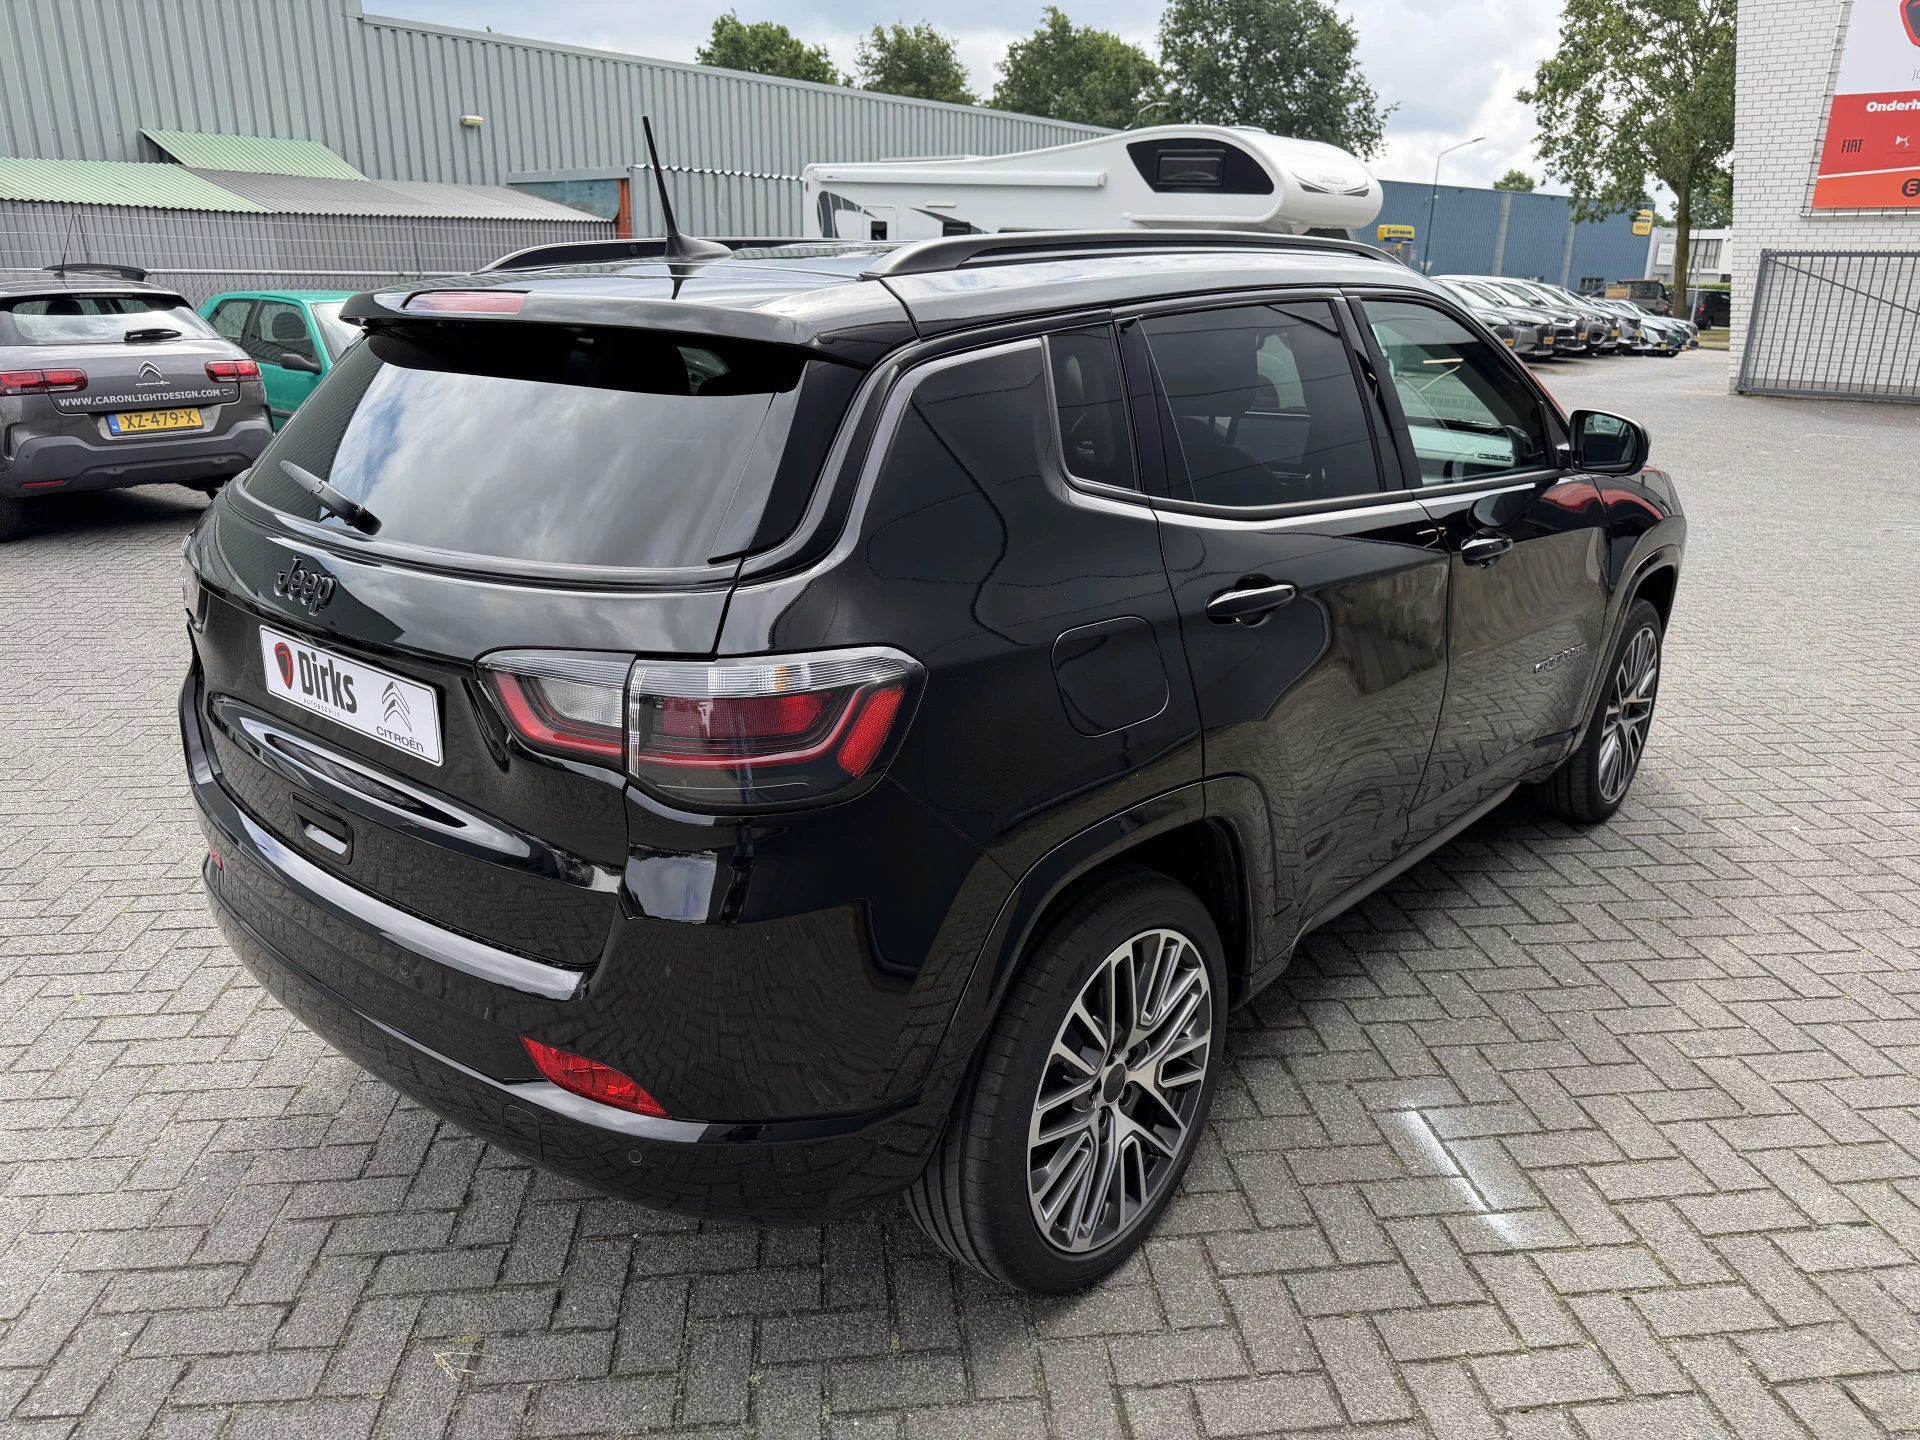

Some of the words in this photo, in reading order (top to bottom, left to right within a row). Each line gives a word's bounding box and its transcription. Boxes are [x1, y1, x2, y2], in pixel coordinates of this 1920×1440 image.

[1841, 139, 1864, 153] FIAT
[123, 410, 196, 429] XZ-479-X
[274, 555, 338, 616] Jeep
[297, 650, 358, 714] Dirks
[376, 726, 425, 753] CITROËN
